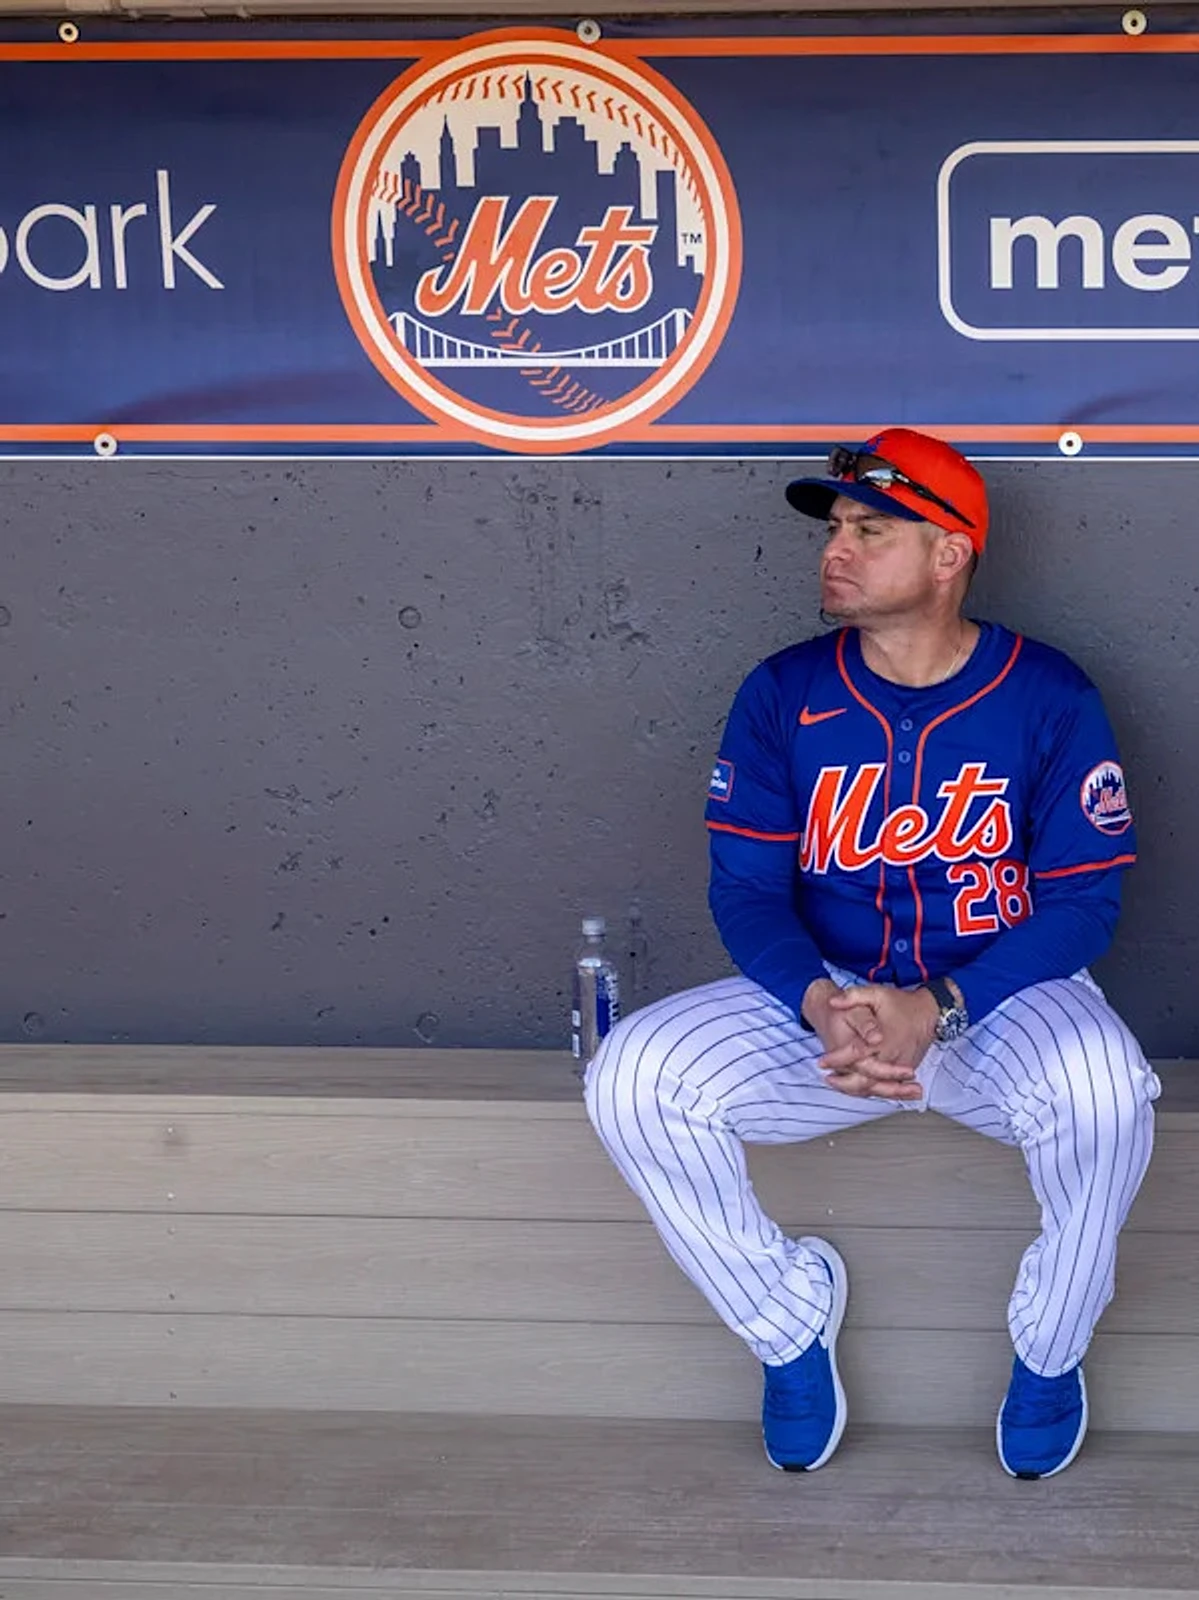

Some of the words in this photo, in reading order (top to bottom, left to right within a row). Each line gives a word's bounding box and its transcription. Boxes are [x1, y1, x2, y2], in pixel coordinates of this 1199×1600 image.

[0, 169, 226, 291] ark
[415, 195, 658, 315] Mets
[680, 232, 703, 245] TM
[799, 762, 1013, 874] Mets
[946, 859, 1033, 937] 28
